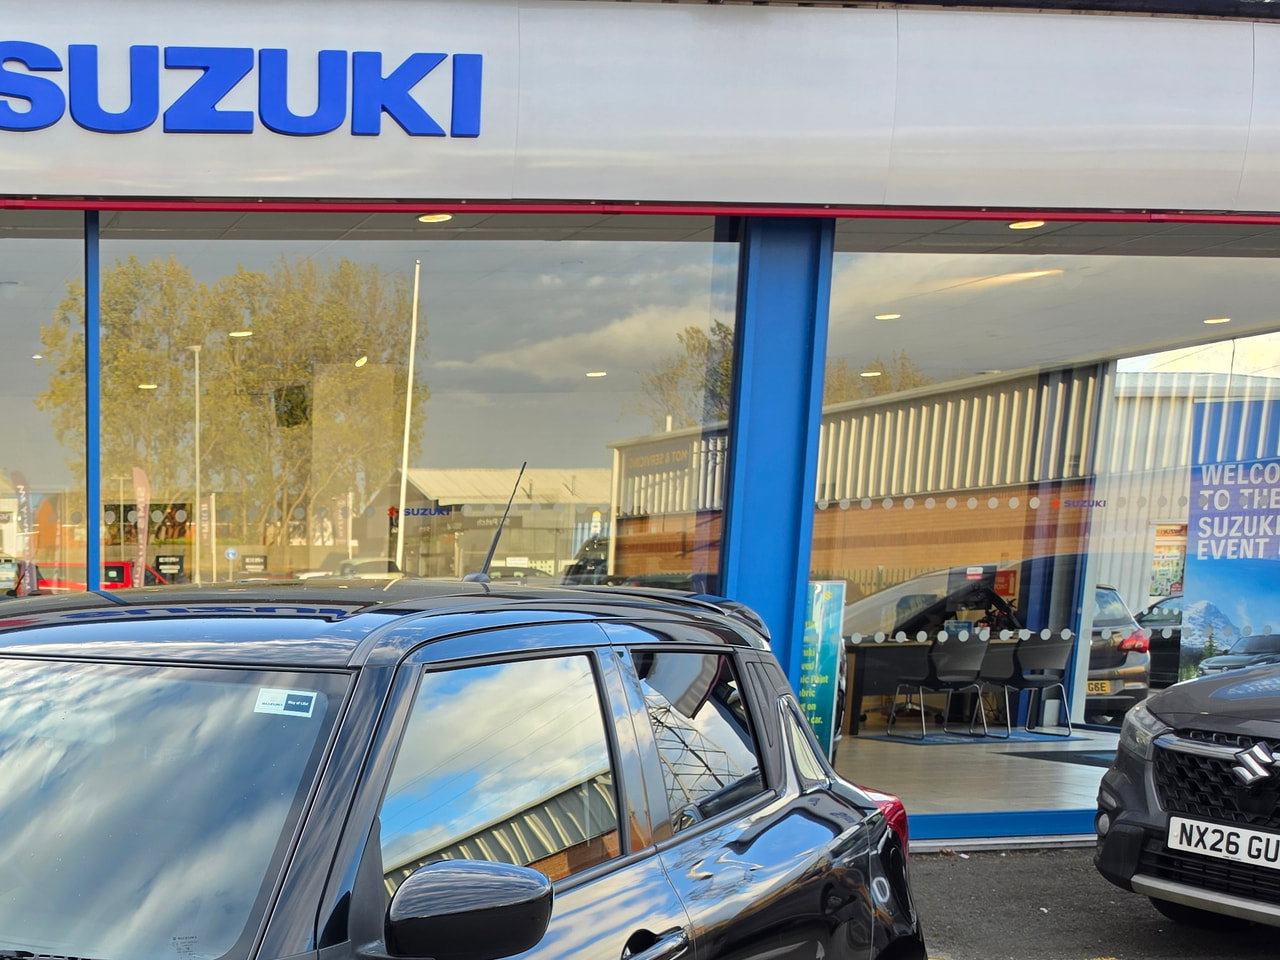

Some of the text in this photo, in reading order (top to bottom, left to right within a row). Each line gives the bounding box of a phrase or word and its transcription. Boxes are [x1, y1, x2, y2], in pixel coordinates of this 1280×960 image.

[1063, 500, 1106, 508] SUZUKI
[1200, 489, 1230, 510] TO
[404, 508, 451, 516] SUZUKI
[1197, 538, 1270, 560] EVENT
[1179, 822, 1280, 862] NX26 GU
